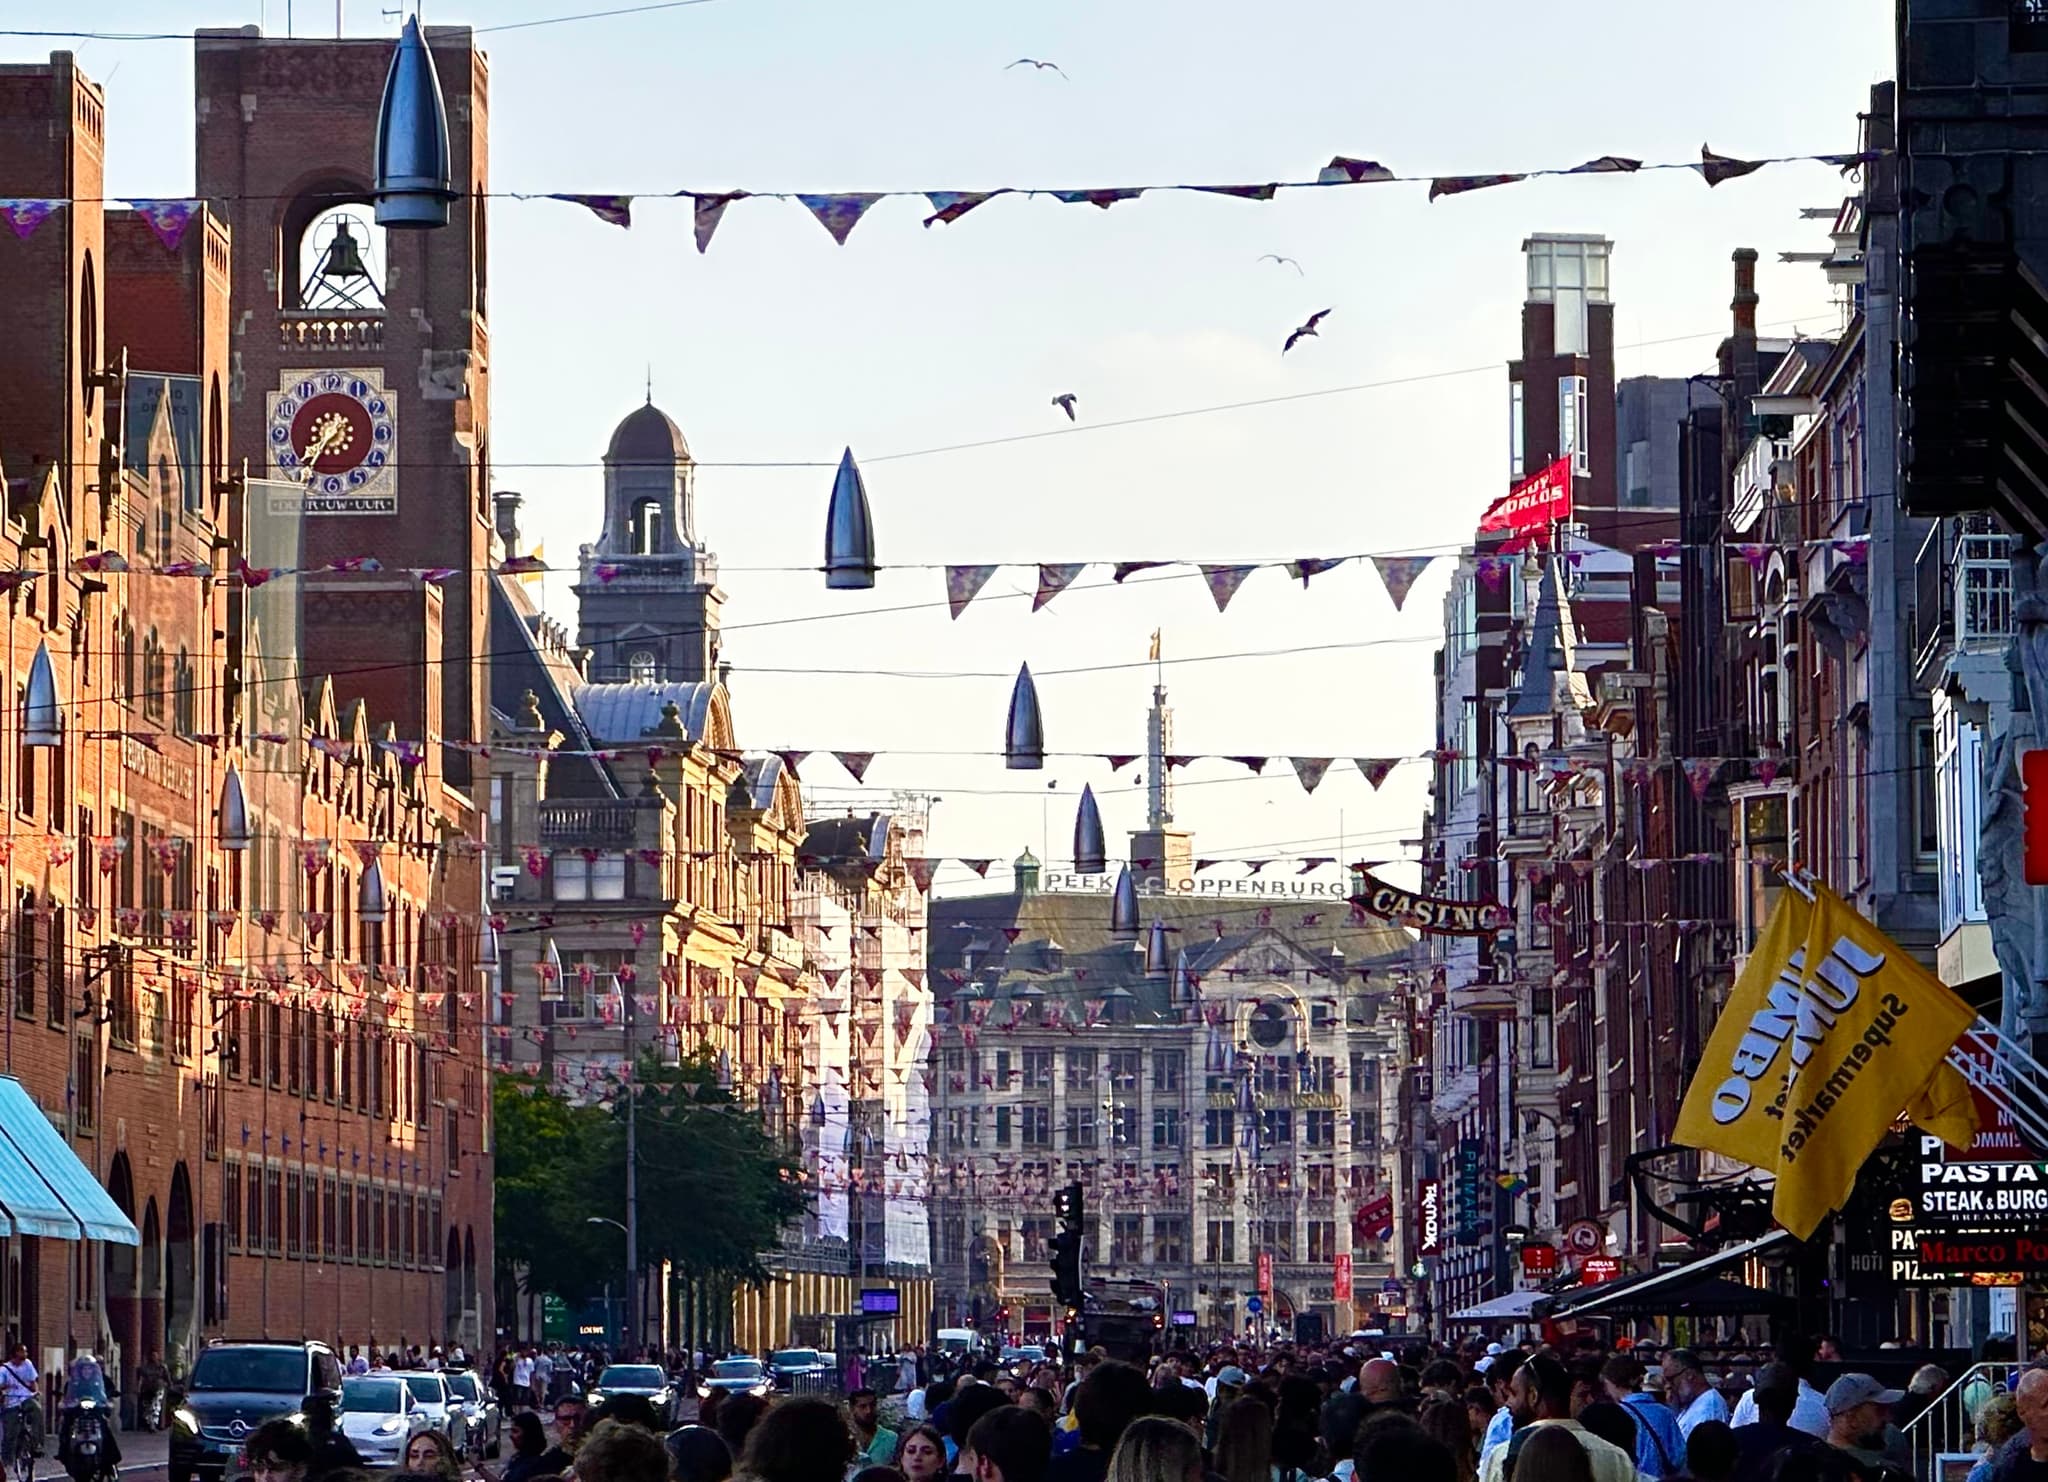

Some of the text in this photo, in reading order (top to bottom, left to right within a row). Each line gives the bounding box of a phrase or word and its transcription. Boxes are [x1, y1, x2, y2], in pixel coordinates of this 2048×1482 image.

[301, 382, 313, 395] 11
[325, 375, 339, 390] 12
[279, 402, 294, 416] 10
[372, 400, 382, 414] 2
[275, 427, 285, 442] 9
[379, 426, 389, 441] 3
[371, 452, 382, 466] 4
[328, 478, 338, 492] 6
[354, 471, 363, 486] 5
[280, 500, 318, 510] DUR
[1048, 873, 1347, 896] PEEK CLOPPENBURG
[1921, 1163, 2039, 1183] PASTA
[1464, 1151, 1477, 1233] PRIMARK
[1922, 1190, 1984, 1212] STEAK
[1986, 1197, 1995, 1210] &
[1951, 1211, 2041, 1221] BREAKFAST
[1921, 1240, 2007, 1264] Marco
[1851, 1253, 1883, 1273] HOT
